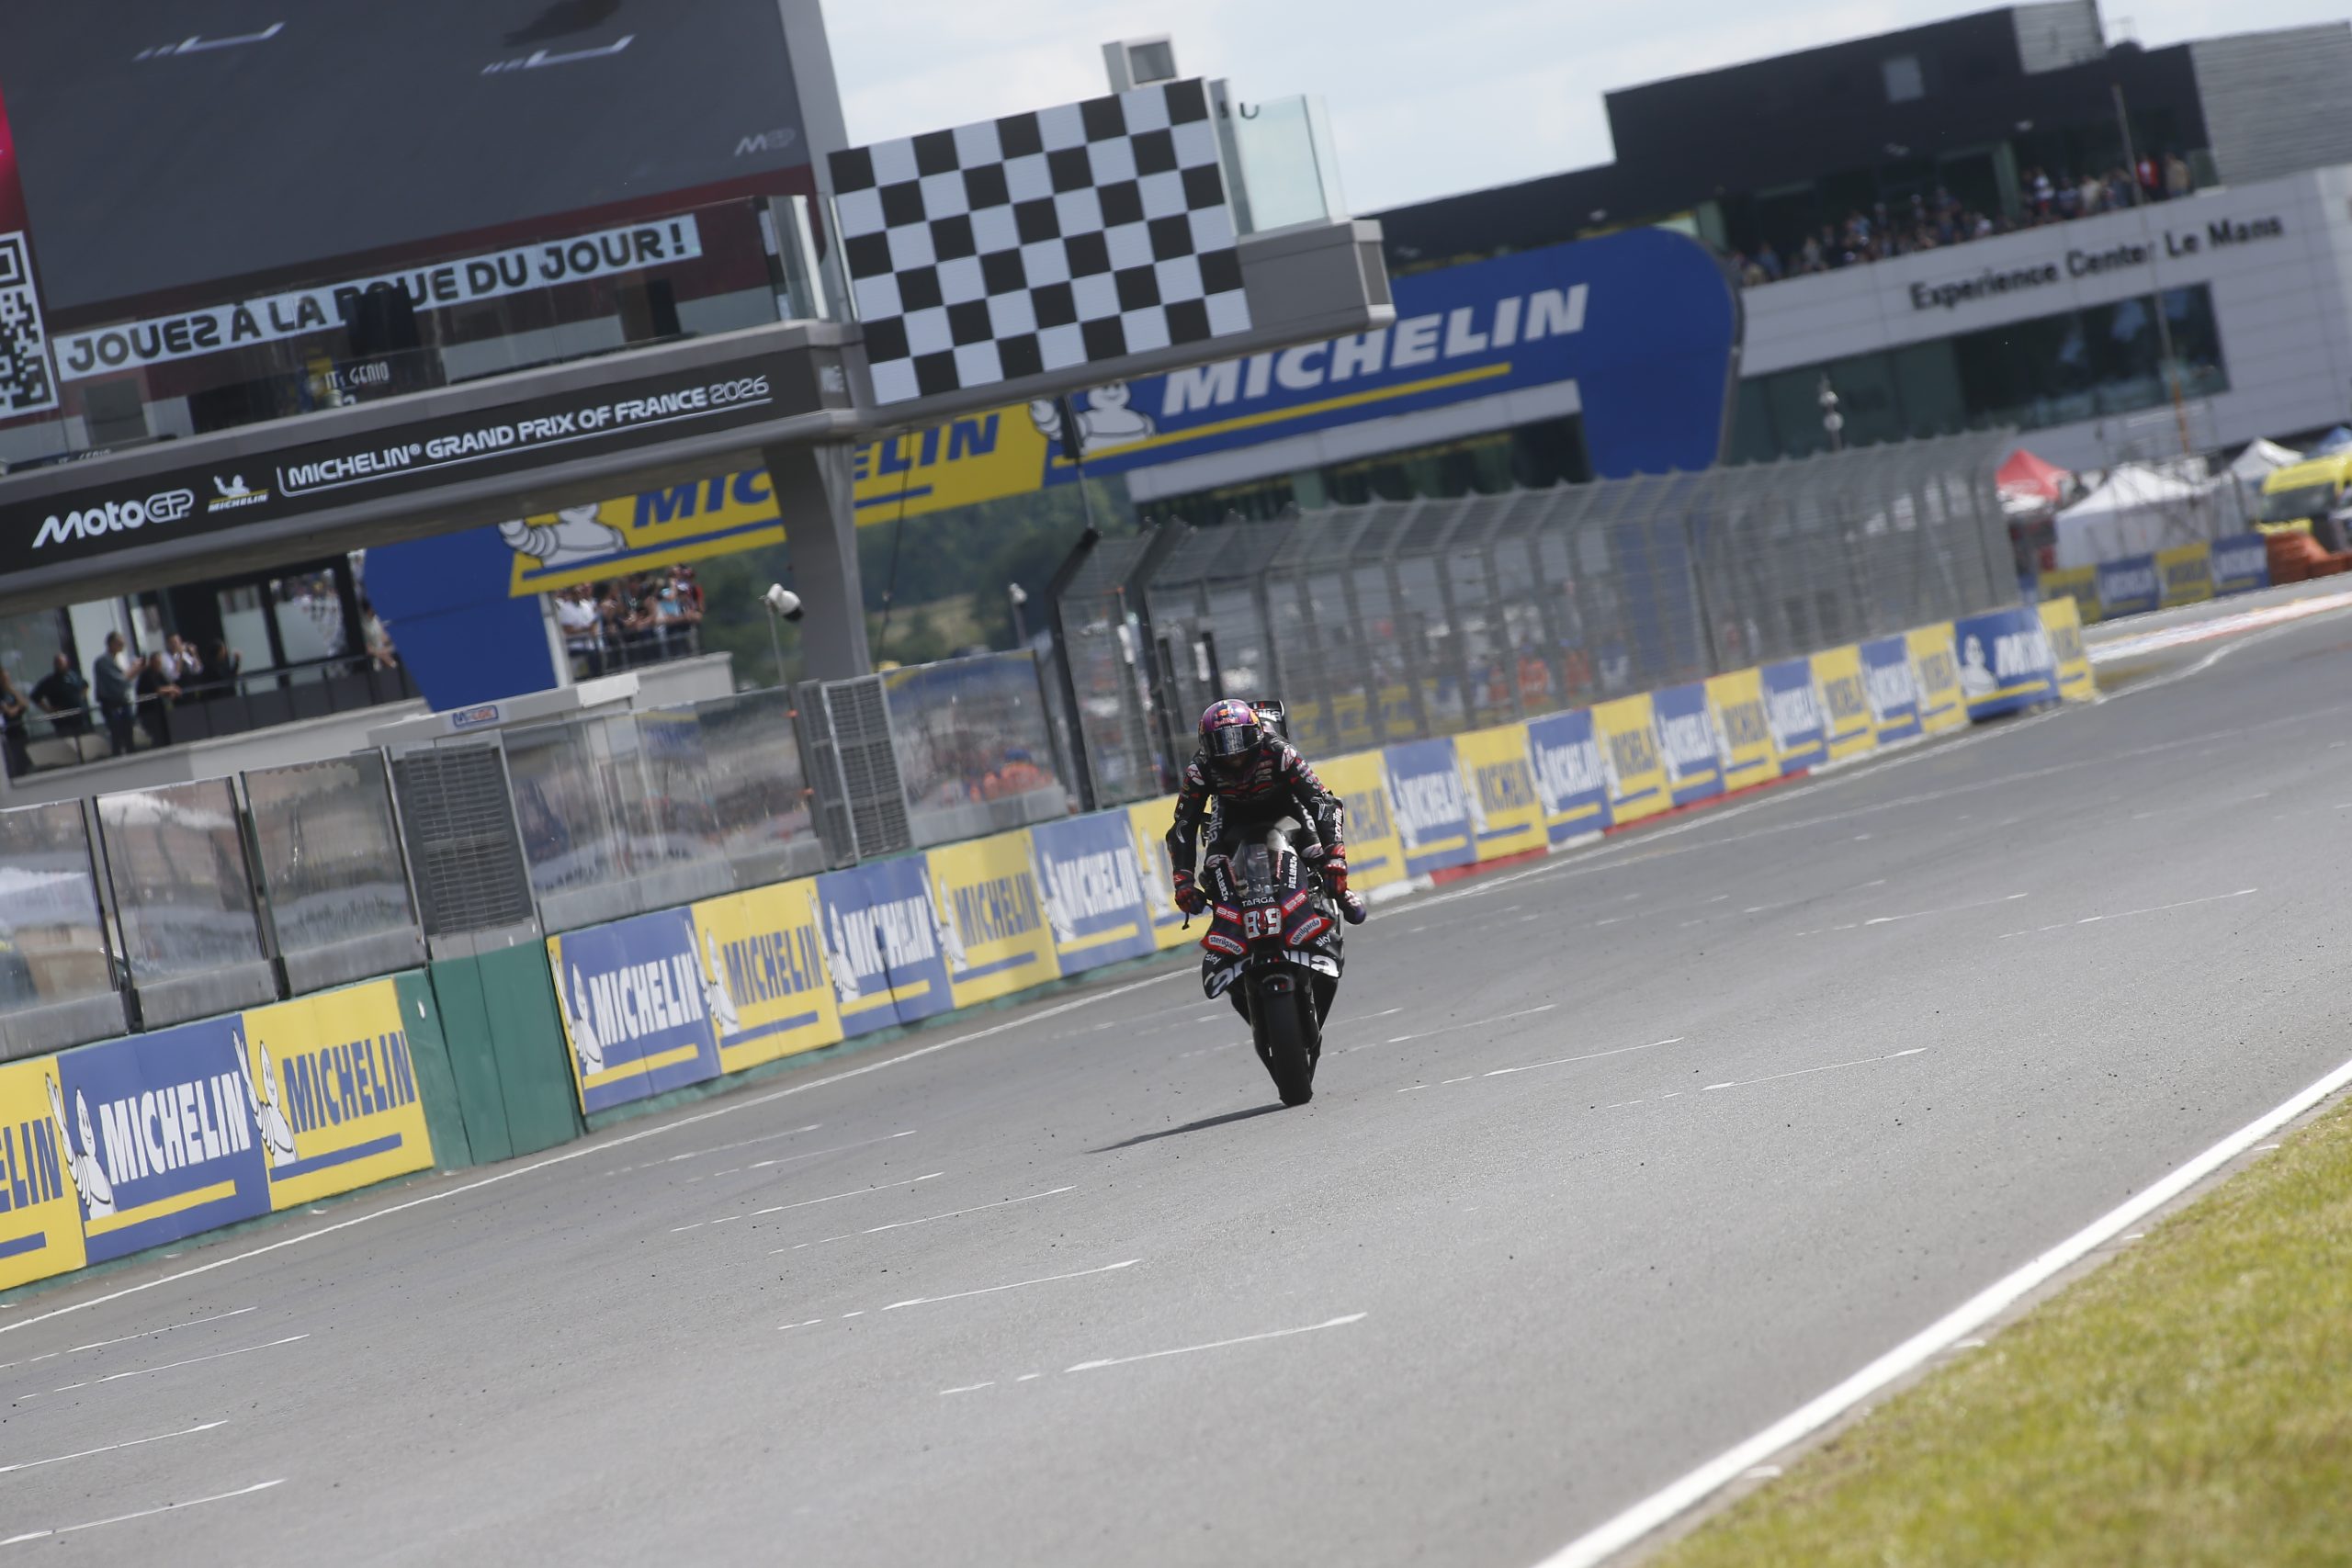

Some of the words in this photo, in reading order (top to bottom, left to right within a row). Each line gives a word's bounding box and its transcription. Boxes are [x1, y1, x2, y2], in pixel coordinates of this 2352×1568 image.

[268, 294, 327, 333] LA
[466, 254, 527, 296] DU
[539, 229, 663, 279] JOUR
[1909, 261, 2058, 310] Experience
[2064, 241, 2155, 278] Center
[2165, 230, 2199, 257] Le
[2207, 215, 2284, 249] Mans
[1161, 283, 1589, 416] MICHELIN
[425, 424, 514, 459] GRAND
[518, 412, 577, 443] PRIX
[578, 405, 612, 429] OF
[615, 387, 707, 423] FRANCE
[709, 376, 771, 404] 2026
[634, 413, 1000, 528] MICELIN
[32, 488, 194, 548] MotoGP
[953, 871, 1043, 948] MICHELIN
[1057, 846, 1142, 919] MICHELIN
[1242, 897, 1275, 908] TARGA
[1204, 953, 1221, 965] sky
[1210, 936, 1242, 953] sterilgarda
[1244, 908, 1282, 939] 89
[1292, 919, 1320, 943] sterilgarda
[1316, 933, 1331, 947] sky
[589, 952, 704, 1047] MICHELIN
[723, 924, 824, 1008] MICHELIN
[282, 1031, 416, 1133] MICHELIN
[99, 1071, 251, 1186] MICHELIN
